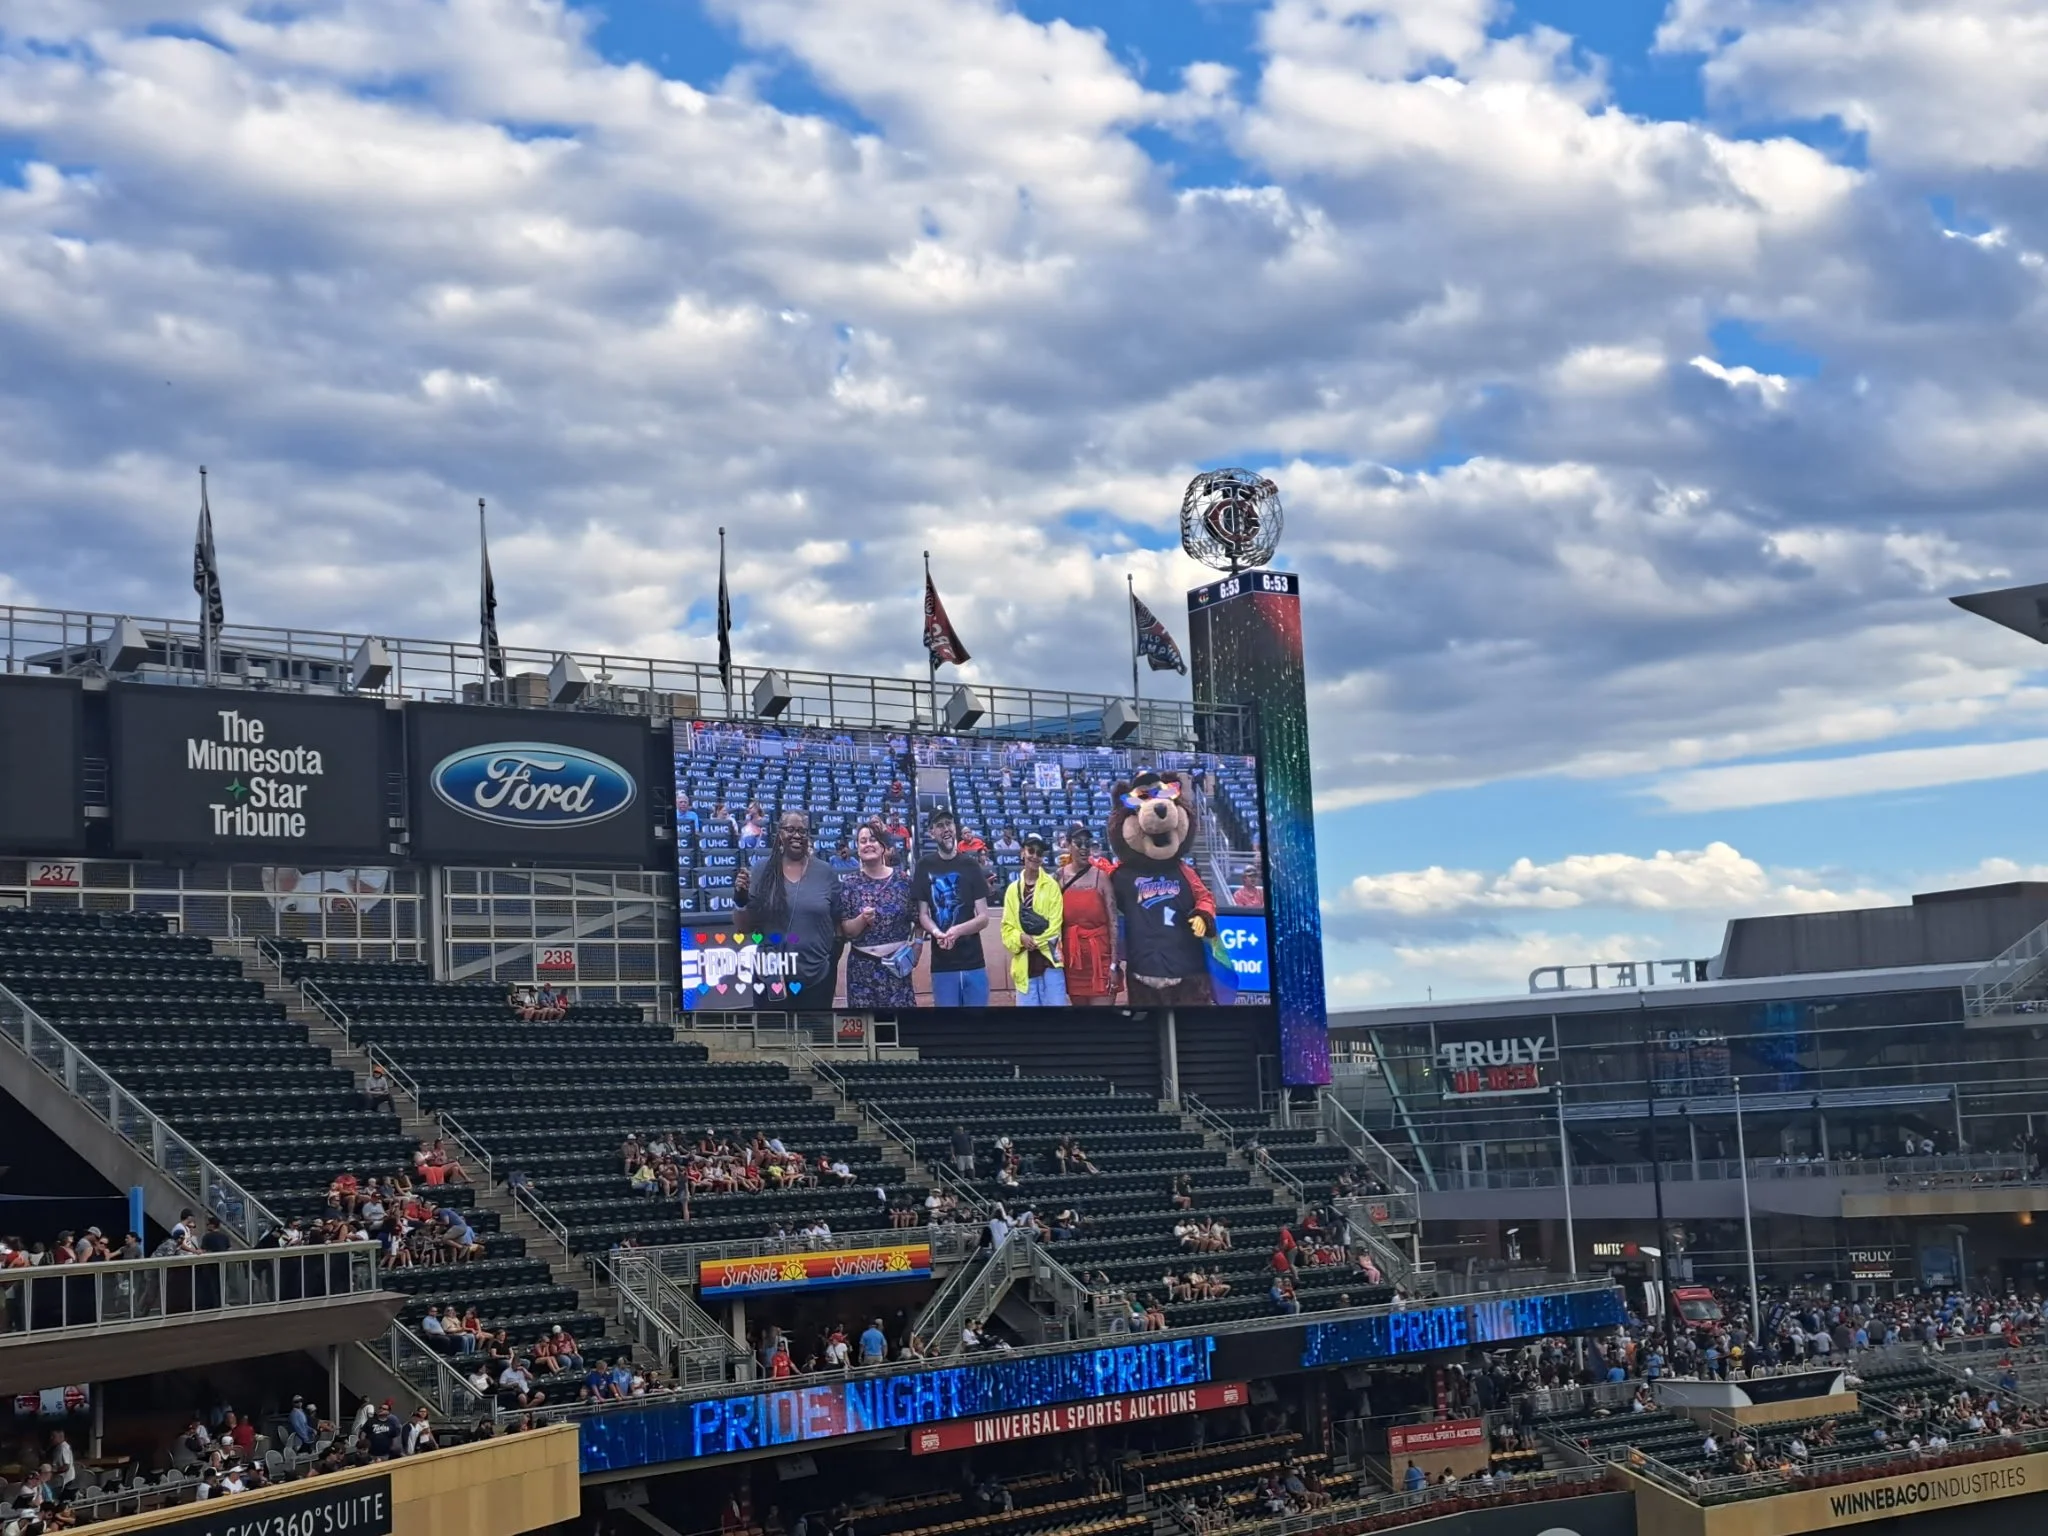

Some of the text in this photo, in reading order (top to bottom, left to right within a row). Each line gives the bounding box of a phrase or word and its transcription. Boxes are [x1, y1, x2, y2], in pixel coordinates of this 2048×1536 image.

[1220, 578, 1240, 599] 6:53
[1263, 575, 1288, 592] 6:53
[218, 710, 264, 744] The
[187, 738, 324, 775] Minnesota
[250, 776, 308, 809] Star
[475, 756, 597, 813] Ford
[209, 803, 306, 838] Tribune
[710, 825, 729, 833] UHC
[708, 839, 728, 847] UHC
[714, 856, 736, 864] UHC
[1003, 856, 1020, 864] UHC
[40, 865, 75, 881] 237
[708, 876, 732, 885] UHC
[1134, 876, 1180, 903] Twins
[1220, 929, 1259, 949] GF+
[544, 950, 573, 964] 238
[697, 952, 799, 975] PRIDE NIGHT
[842, 1018, 863, 1031] 239
[1442, 1036, 1546, 1068] TRULY
[1849, 1250, 1892, 1262] TRULY
[721, 1253, 884, 1290] Surfside Surfside
[1388, 1296, 1545, 1355] PRIDE NIGHT
[1094, 1338, 1196, 1397] PRIDE
[690, 1368, 963, 1457] PRIDE NIGHT
[974, 1389, 1196, 1444] UNIVERSAL SPORTS AUCTIONS
[1406, 1432, 1435, 1443] UNIVERSAL
[1435, 1430, 1456, 1440] SPORTS
[1456, 1427, 1481, 1438] AUCTIONS
